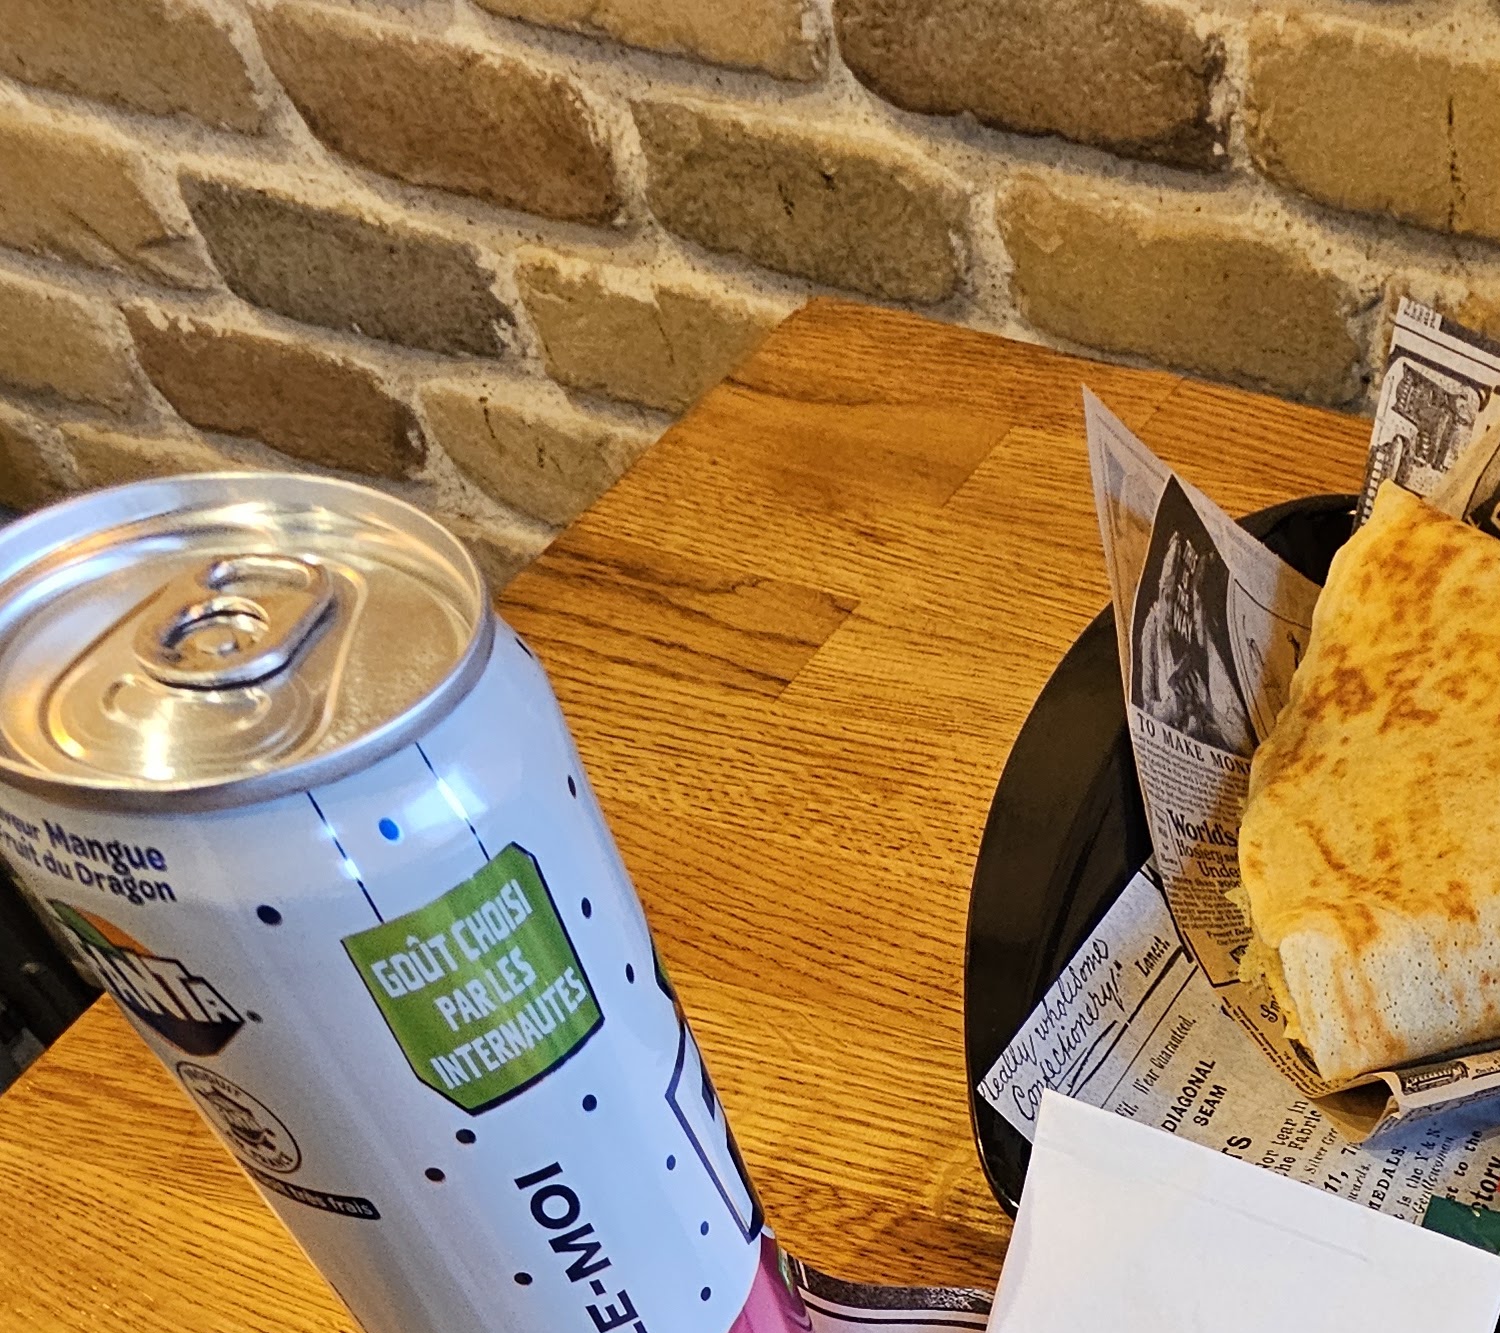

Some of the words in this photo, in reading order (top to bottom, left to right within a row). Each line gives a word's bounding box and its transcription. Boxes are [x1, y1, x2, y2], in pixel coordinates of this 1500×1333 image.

[1136, 712, 1159, 738] TO
[1161, 727, 1205, 762] MAKE
[41, 818, 169, 877] Mangue
[43, 850, 73, 880] du
[74, 862, 178, 906] Dragon
[370, 930, 460, 998] GOÛT
[450, 878, 533, 962] CHOISI
[88, 940, 246, 1026] ANTA
[433, 975, 499, 1032] PAR
[483, 944, 537, 1004] LES
[430, 966, 588, 1090] INTERNAUTES
[1160, 1060, 1217, 1133] DIAGONAL
[1192, 1084, 1228, 1127] SEAM
